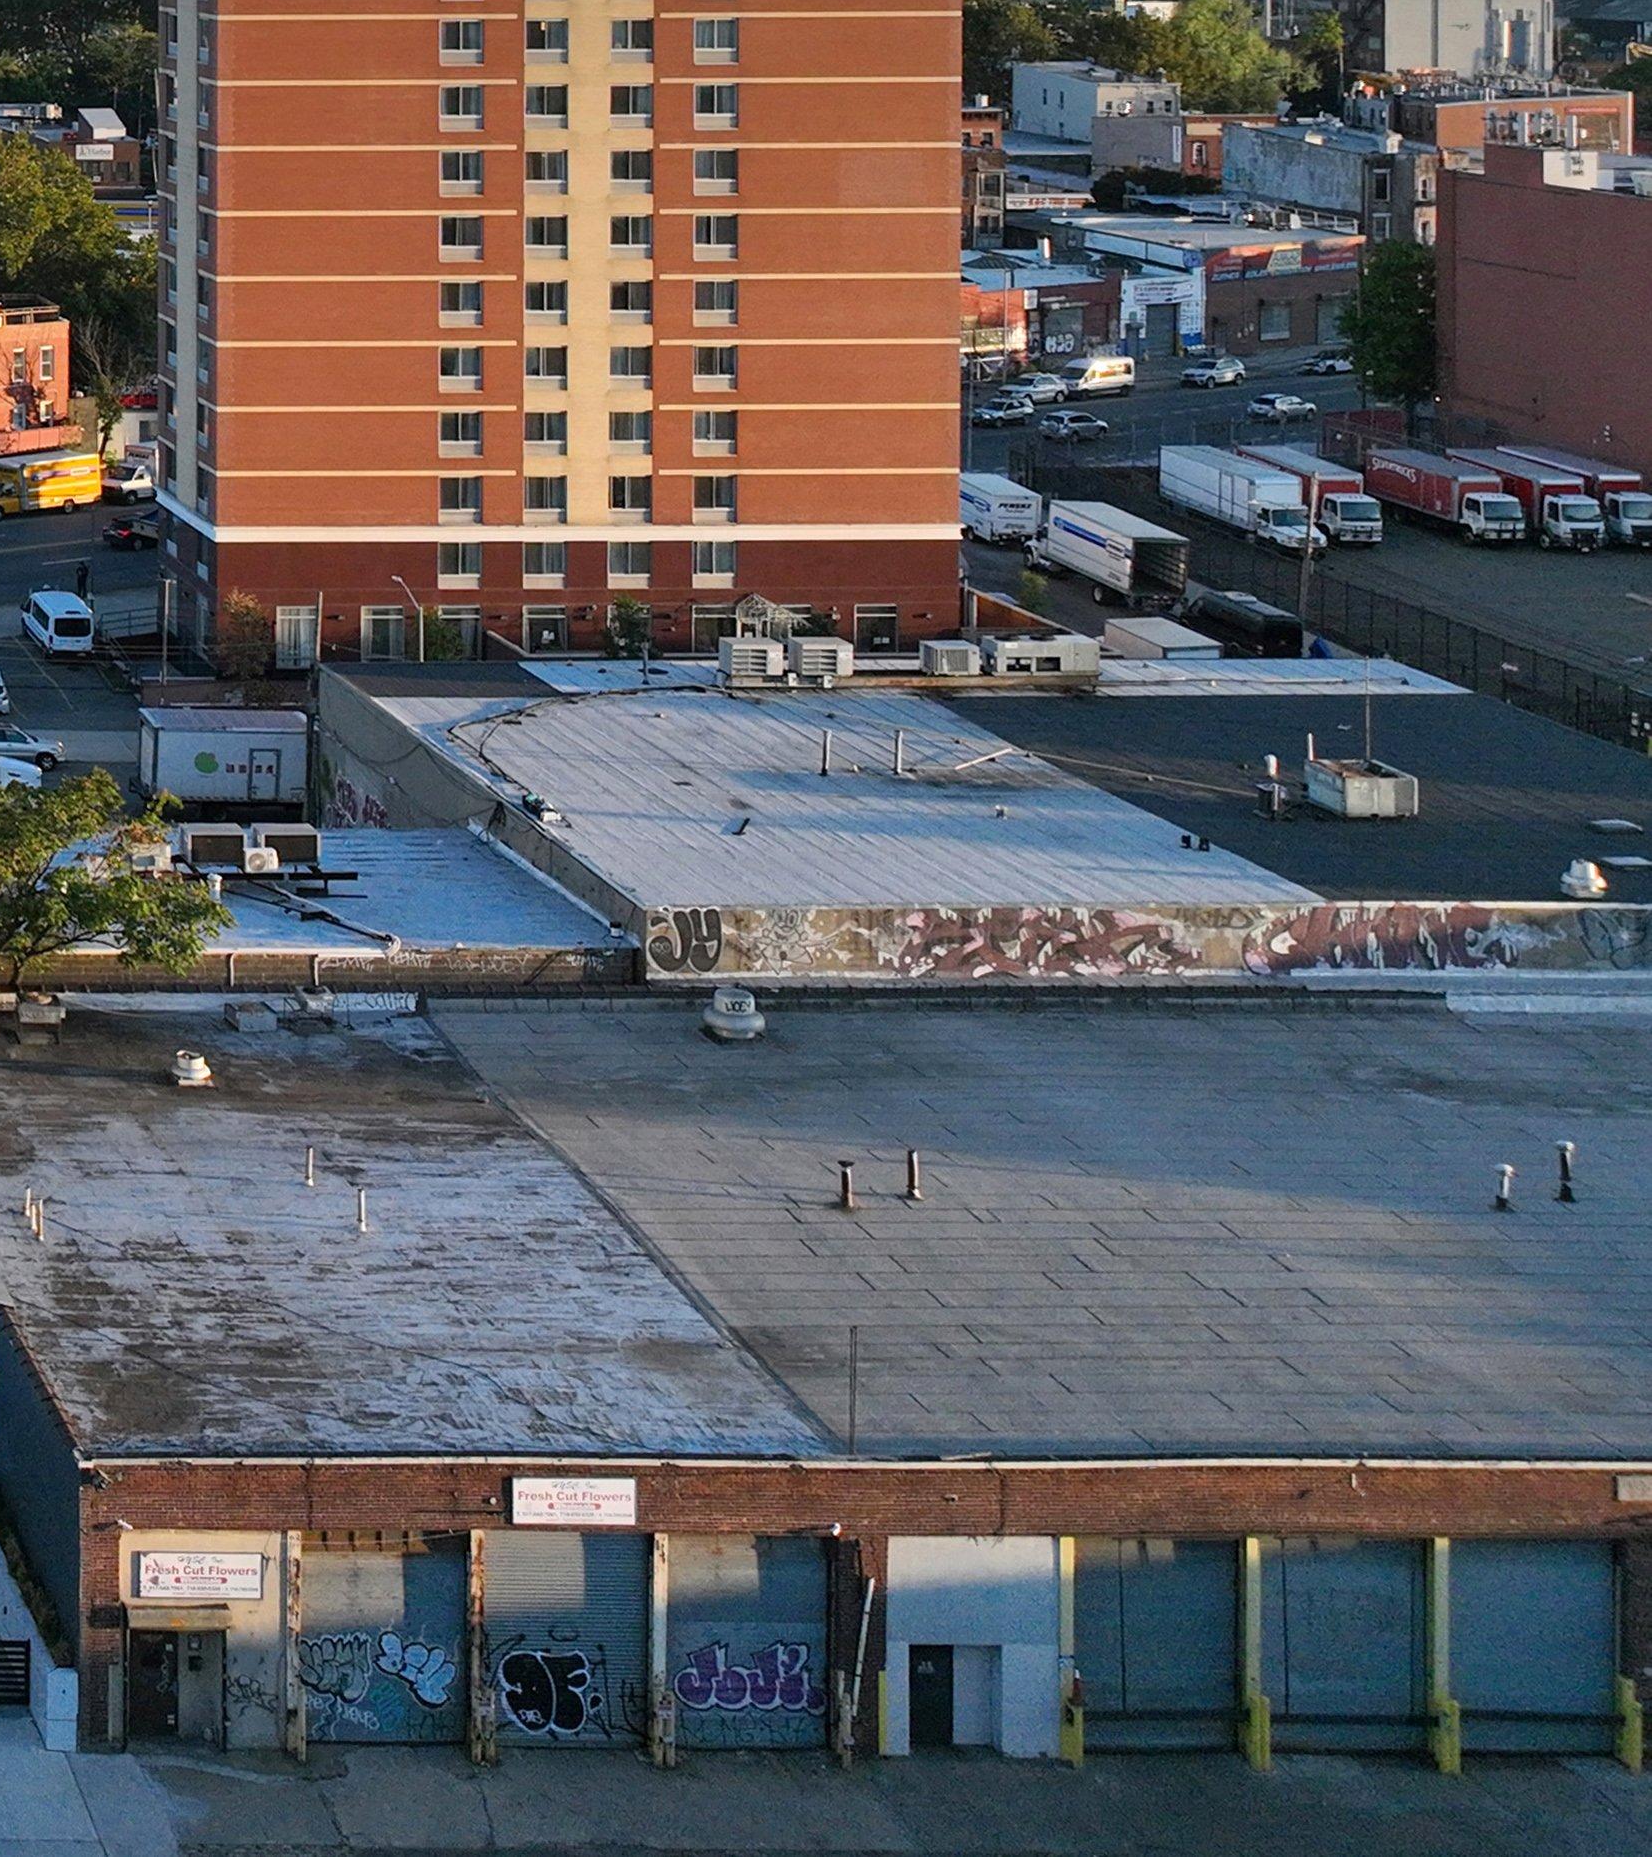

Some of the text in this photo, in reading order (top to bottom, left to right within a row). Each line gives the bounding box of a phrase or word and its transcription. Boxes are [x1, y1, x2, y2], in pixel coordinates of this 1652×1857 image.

[517, 1491, 632, 1502] Fresh Cut Flowers
[144, 1564, 258, 1576] Fresh Cut Flowers
